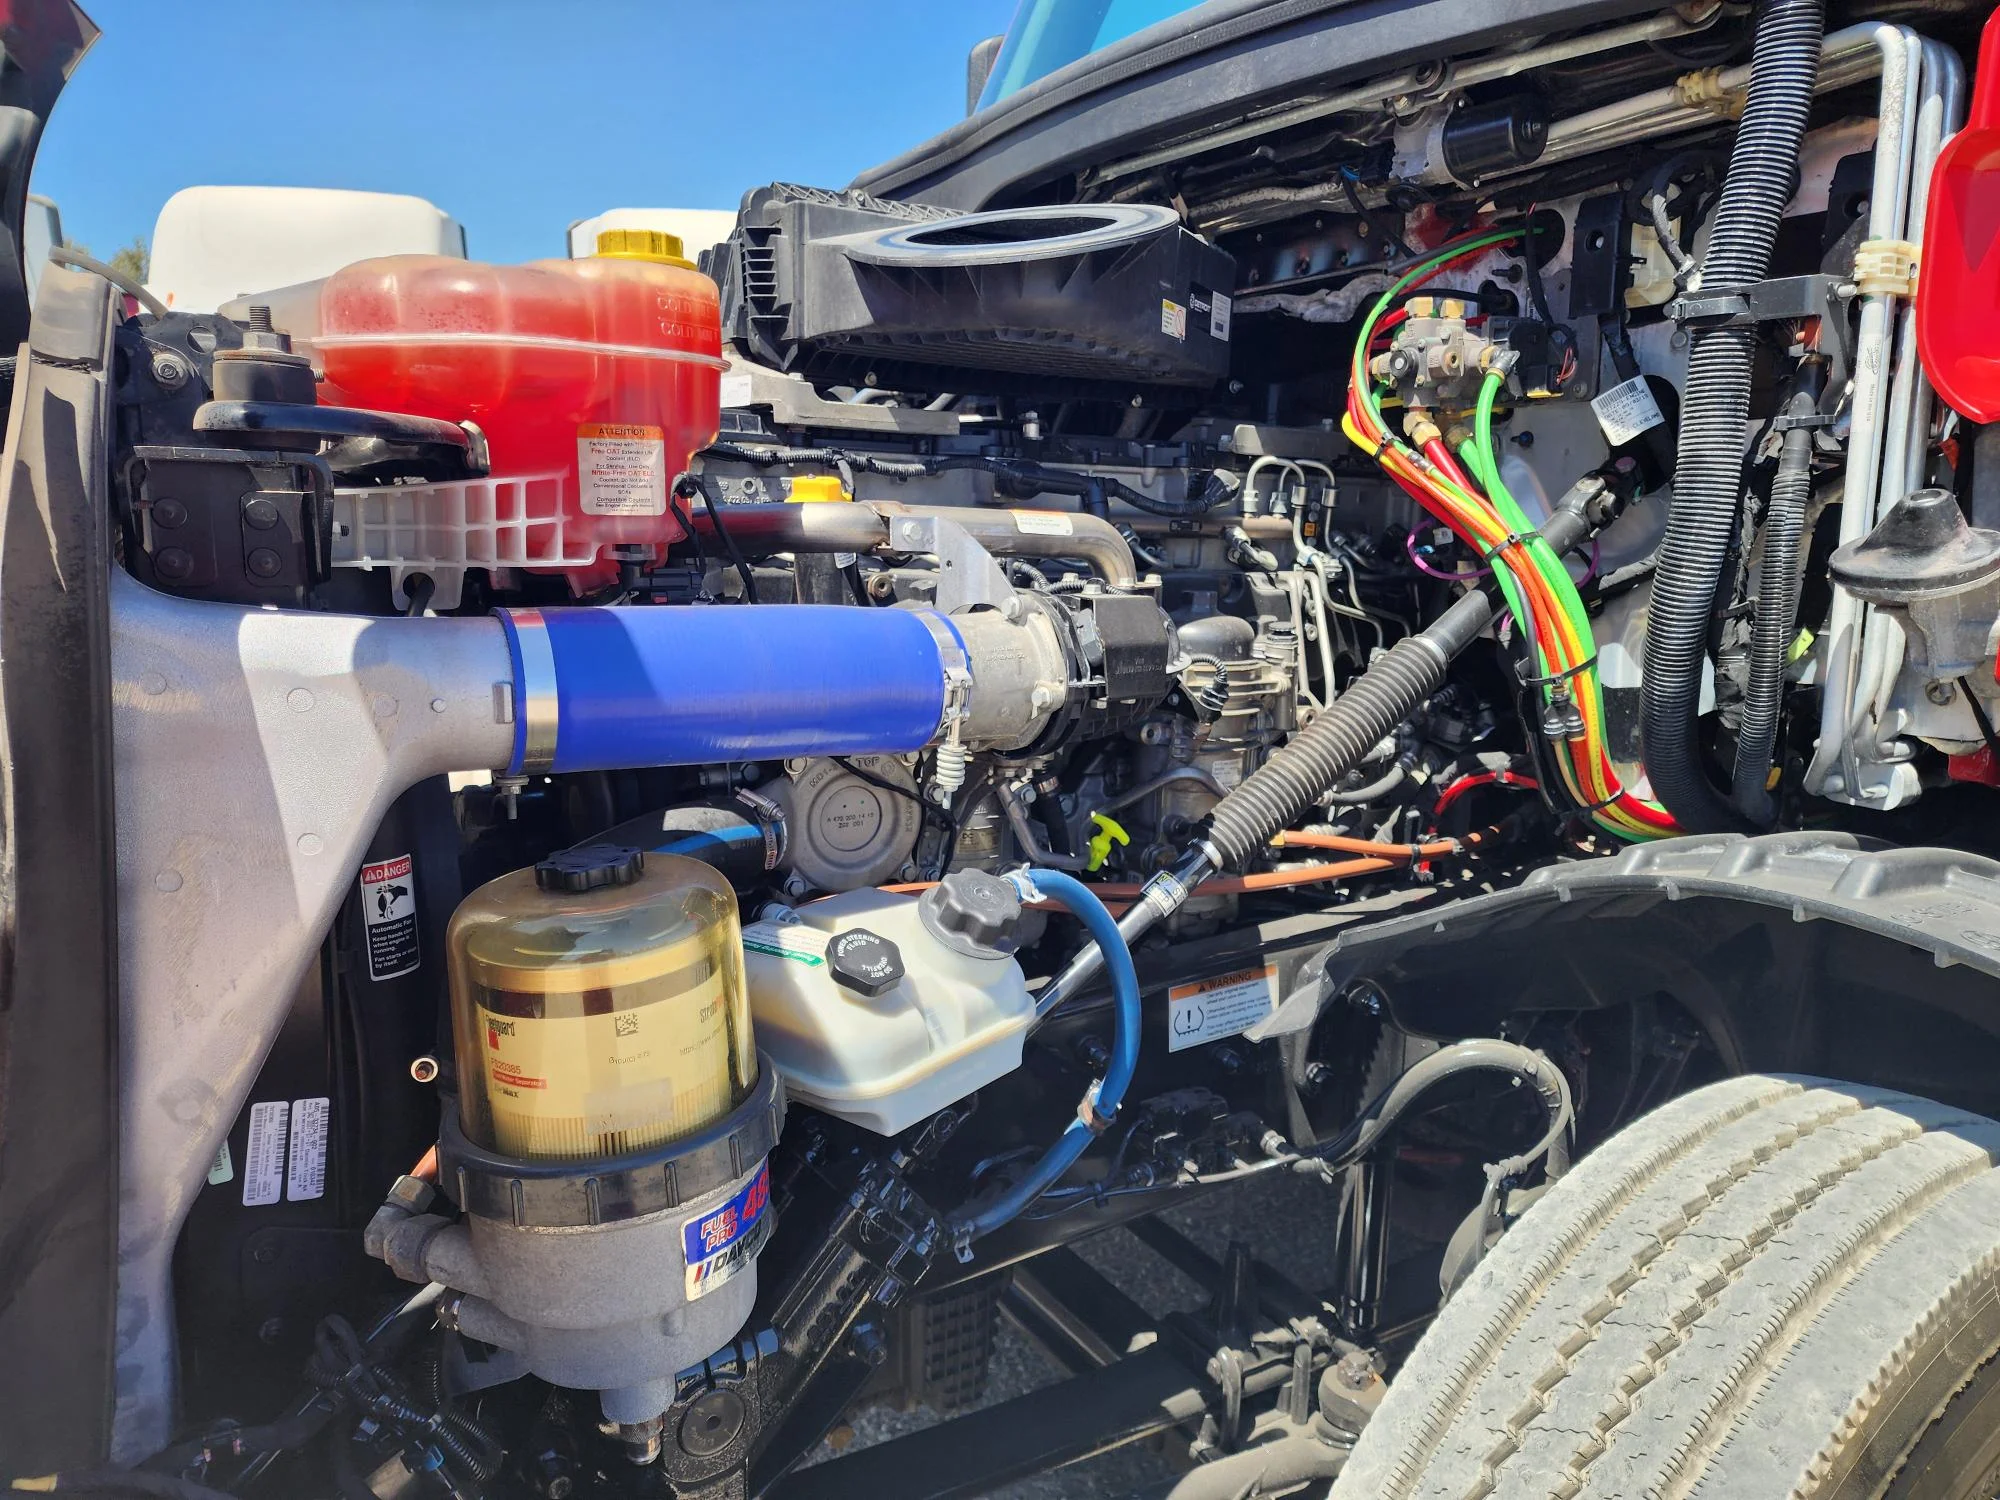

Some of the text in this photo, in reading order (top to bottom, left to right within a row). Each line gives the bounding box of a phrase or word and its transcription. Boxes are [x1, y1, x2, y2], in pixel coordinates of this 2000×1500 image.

[598, 428, 645, 436] ATTENTION
[376, 861, 410, 880] DANGER
[372, 922, 403, 934] Automatic
[845, 934, 880, 945] STEERING
[846, 940, 867, 951] FLUID
[861, 956, 888, 972] OVERFILL
[1208, 971, 1252, 989] WARNING
[701, 1205, 738, 1240] FUEL
[705, 1220, 738, 1253] PRO
